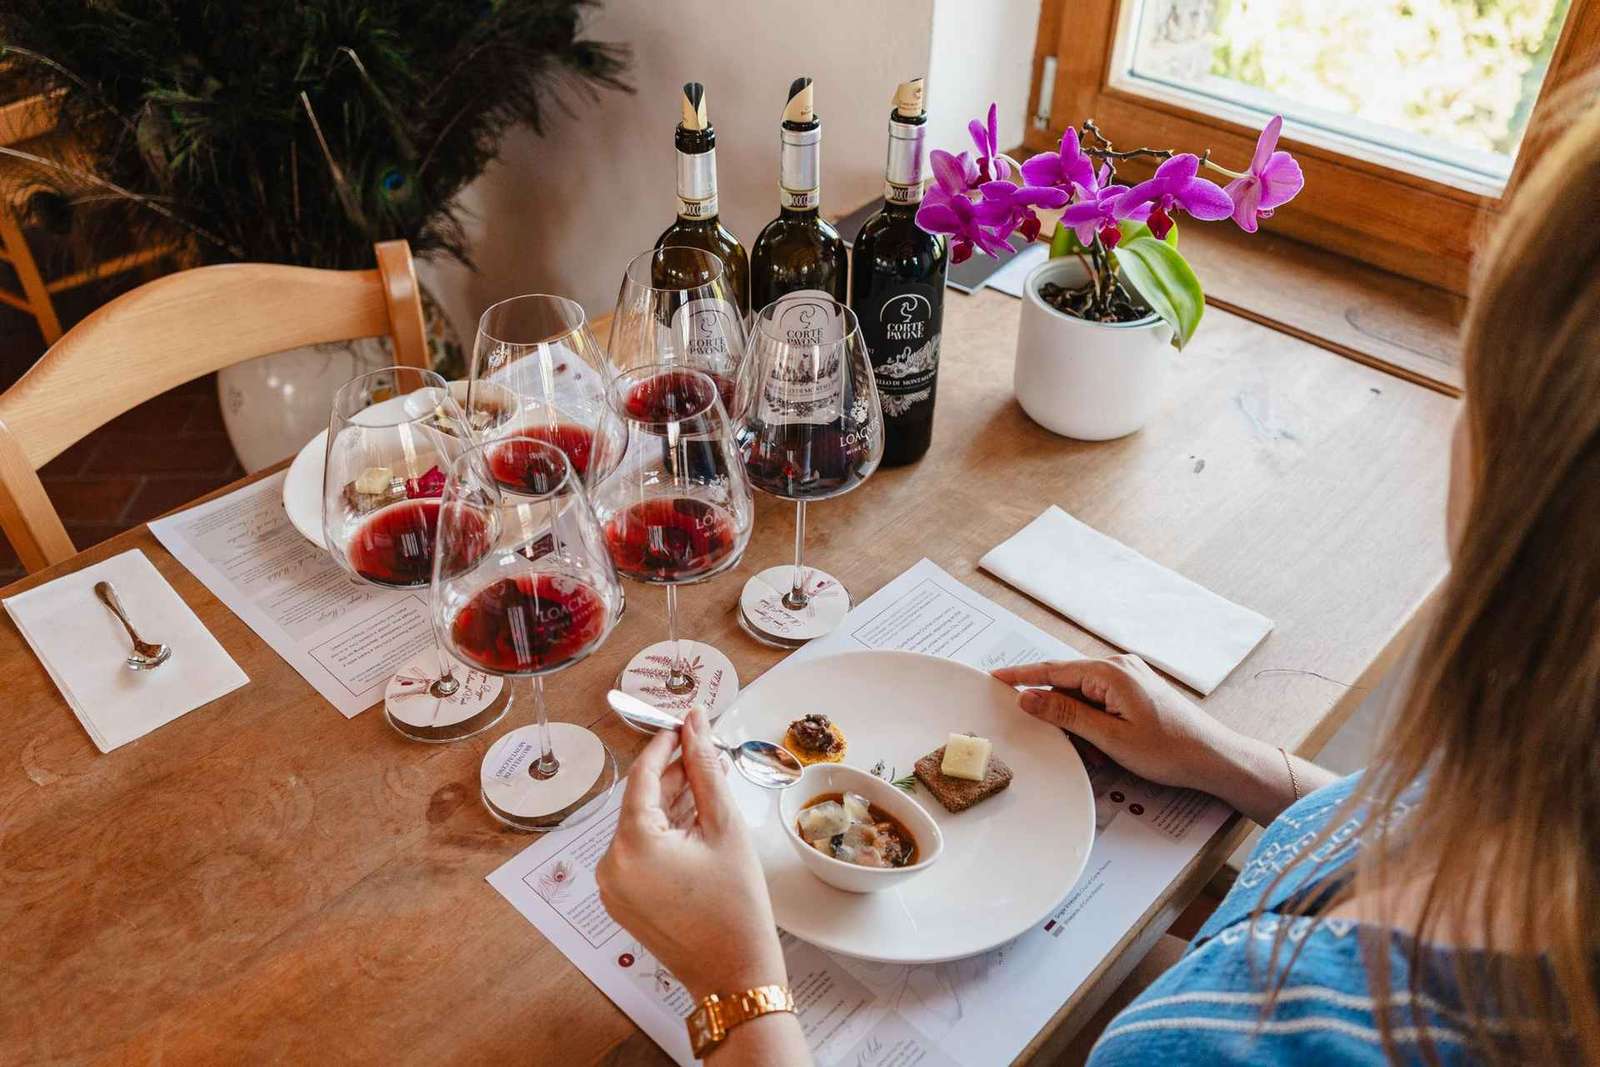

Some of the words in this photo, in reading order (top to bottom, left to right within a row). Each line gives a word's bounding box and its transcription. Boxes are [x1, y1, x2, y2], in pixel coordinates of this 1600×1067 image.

[887, 321, 925, 332] CORTE
[787, 328, 823, 338] CORTE
[887, 330, 924, 340] PAVONE
[689, 337, 727, 347] CORTE
